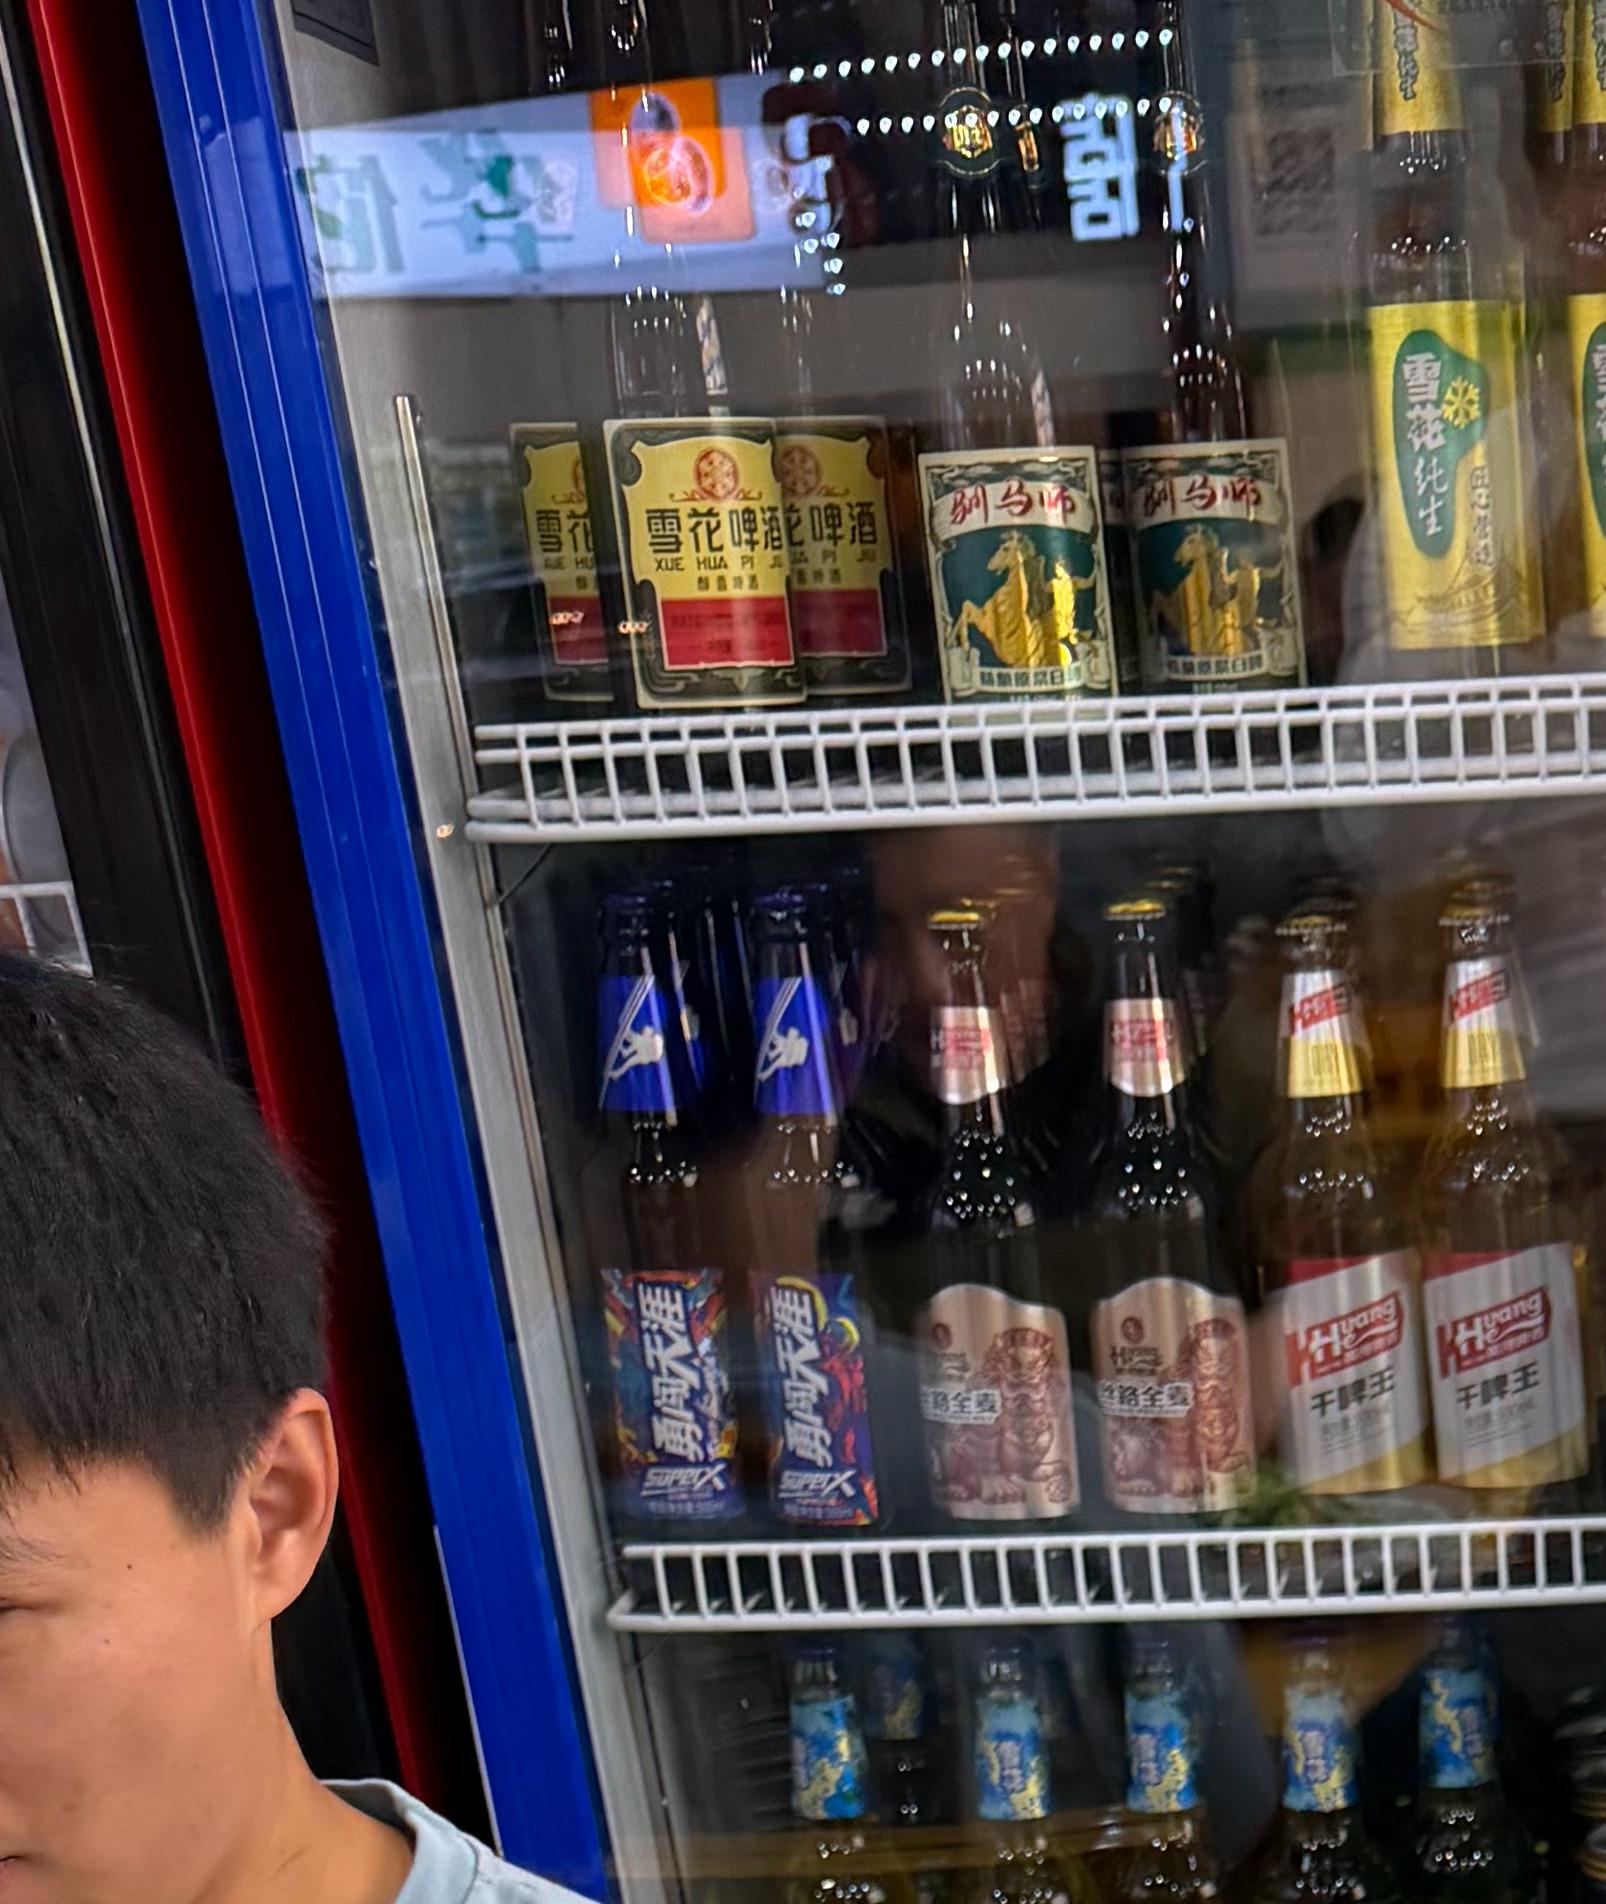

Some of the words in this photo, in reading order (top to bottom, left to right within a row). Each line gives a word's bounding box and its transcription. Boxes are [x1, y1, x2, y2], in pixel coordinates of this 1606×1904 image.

[1402, 352, 1449, 536] 雪花纯生
[655, 557, 685, 572] XUE
[695, 556, 729, 571] HUA
[1311, 1366, 1396, 1417] 干啤王
[1457, 1361, 1541, 1410] 干啤王
